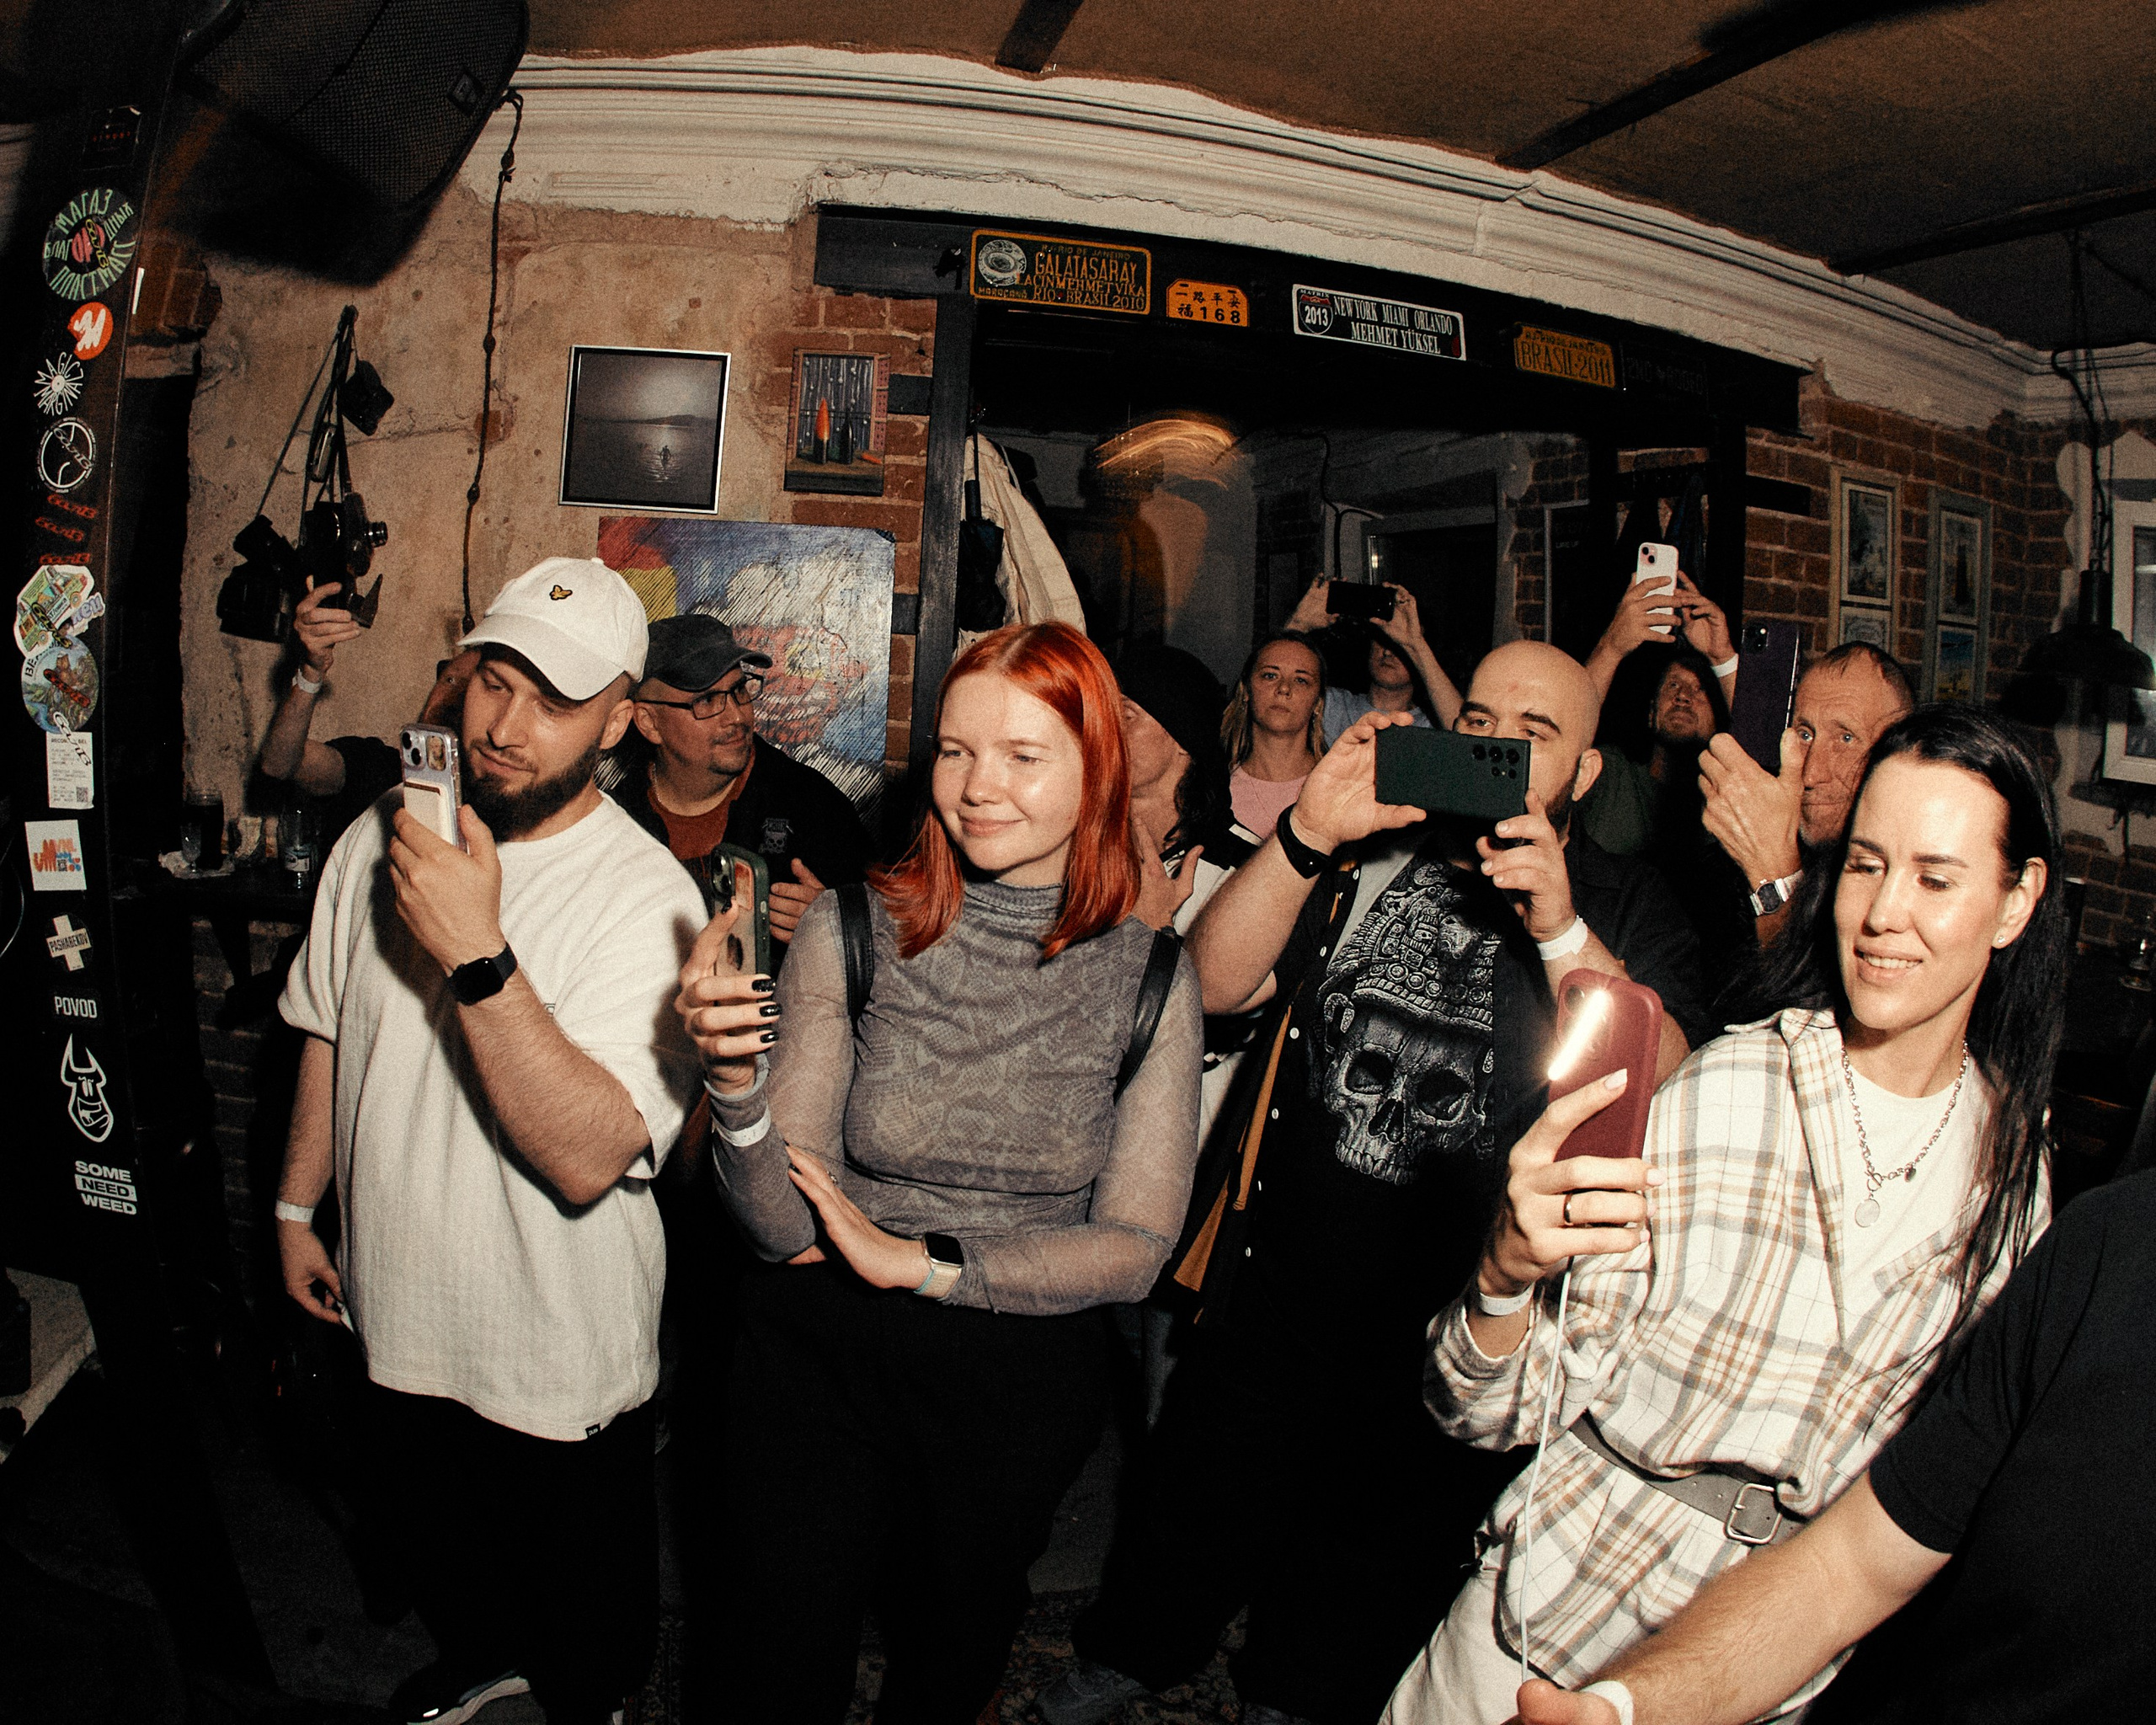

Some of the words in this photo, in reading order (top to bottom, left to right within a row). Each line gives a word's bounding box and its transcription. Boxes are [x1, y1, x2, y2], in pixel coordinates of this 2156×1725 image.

[1035, 252, 1137, 285] GALATASARAY
[1305, 305, 1329, 327] 2013
[1333, 296, 1353, 318] NEW
[1353, 299, 1379, 322] YORK
[1382, 303, 1410, 328] MIAMI
[1414, 310, 1454, 336] ORLANDO
[1351, 321, 1399, 347] MEHMET
[1400, 328, 1442, 355] YÜKSEL
[34, 351, 81, 384] MAGIC
[54, 996, 98, 1018] POVOD
[74, 1161, 132, 1183] SOME
[81, 1178, 130, 1198] NEED
[81, 1193, 137, 1215] WEED
